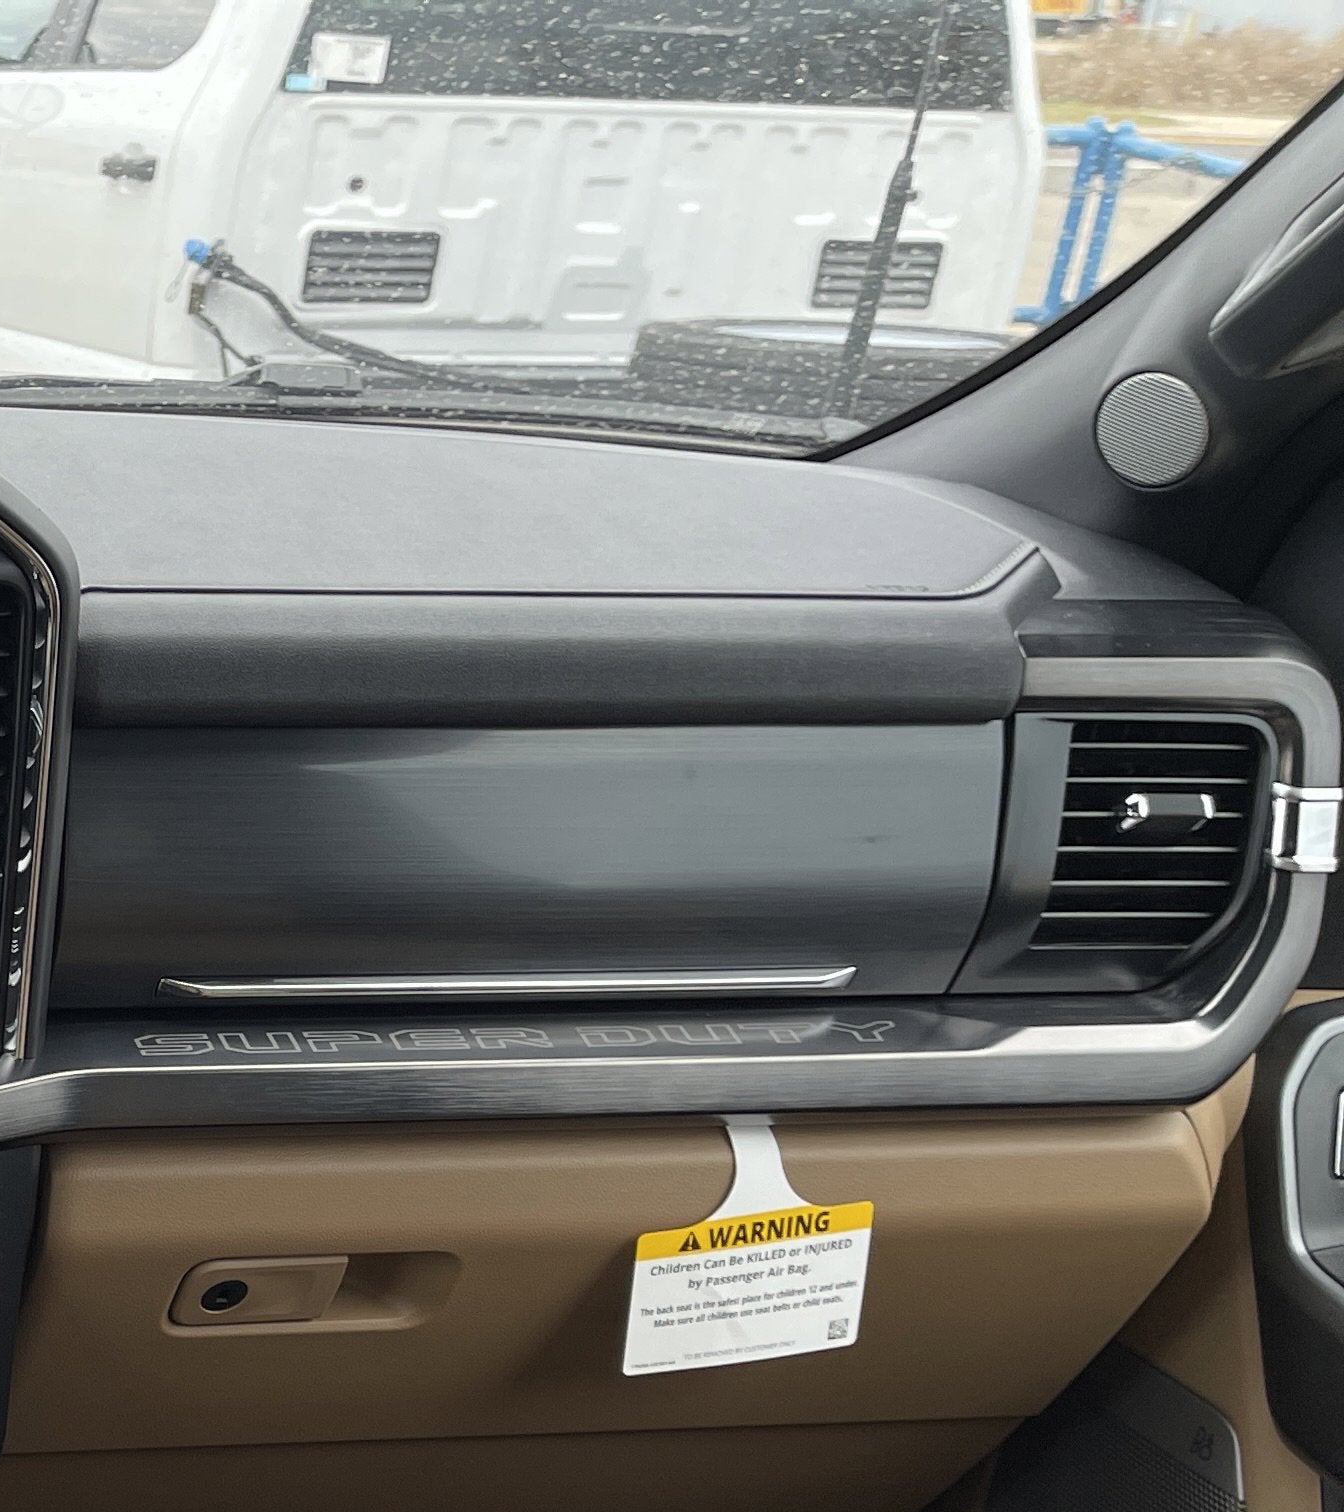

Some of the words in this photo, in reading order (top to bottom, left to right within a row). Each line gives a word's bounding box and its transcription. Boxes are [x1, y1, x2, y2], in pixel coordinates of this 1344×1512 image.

[133, 1027, 556, 1057] SUPER
[580, 1020, 897, 1050] DUTY
[709, 1211, 831, 1249] WARNING
[650, 1261, 700, 1277] Children
[704, 1259, 726, 1270] Can
[729, 1256, 744, 1267] Be
[746, 1248, 786, 1263] KILLED
[789, 1248, 802, 1257] or
[804, 1238, 853, 1256] INJURED
[688, 1279, 703, 1290] by
[706, 1270, 765, 1287] Passenger
[767, 1266, 785, 1277] Air
